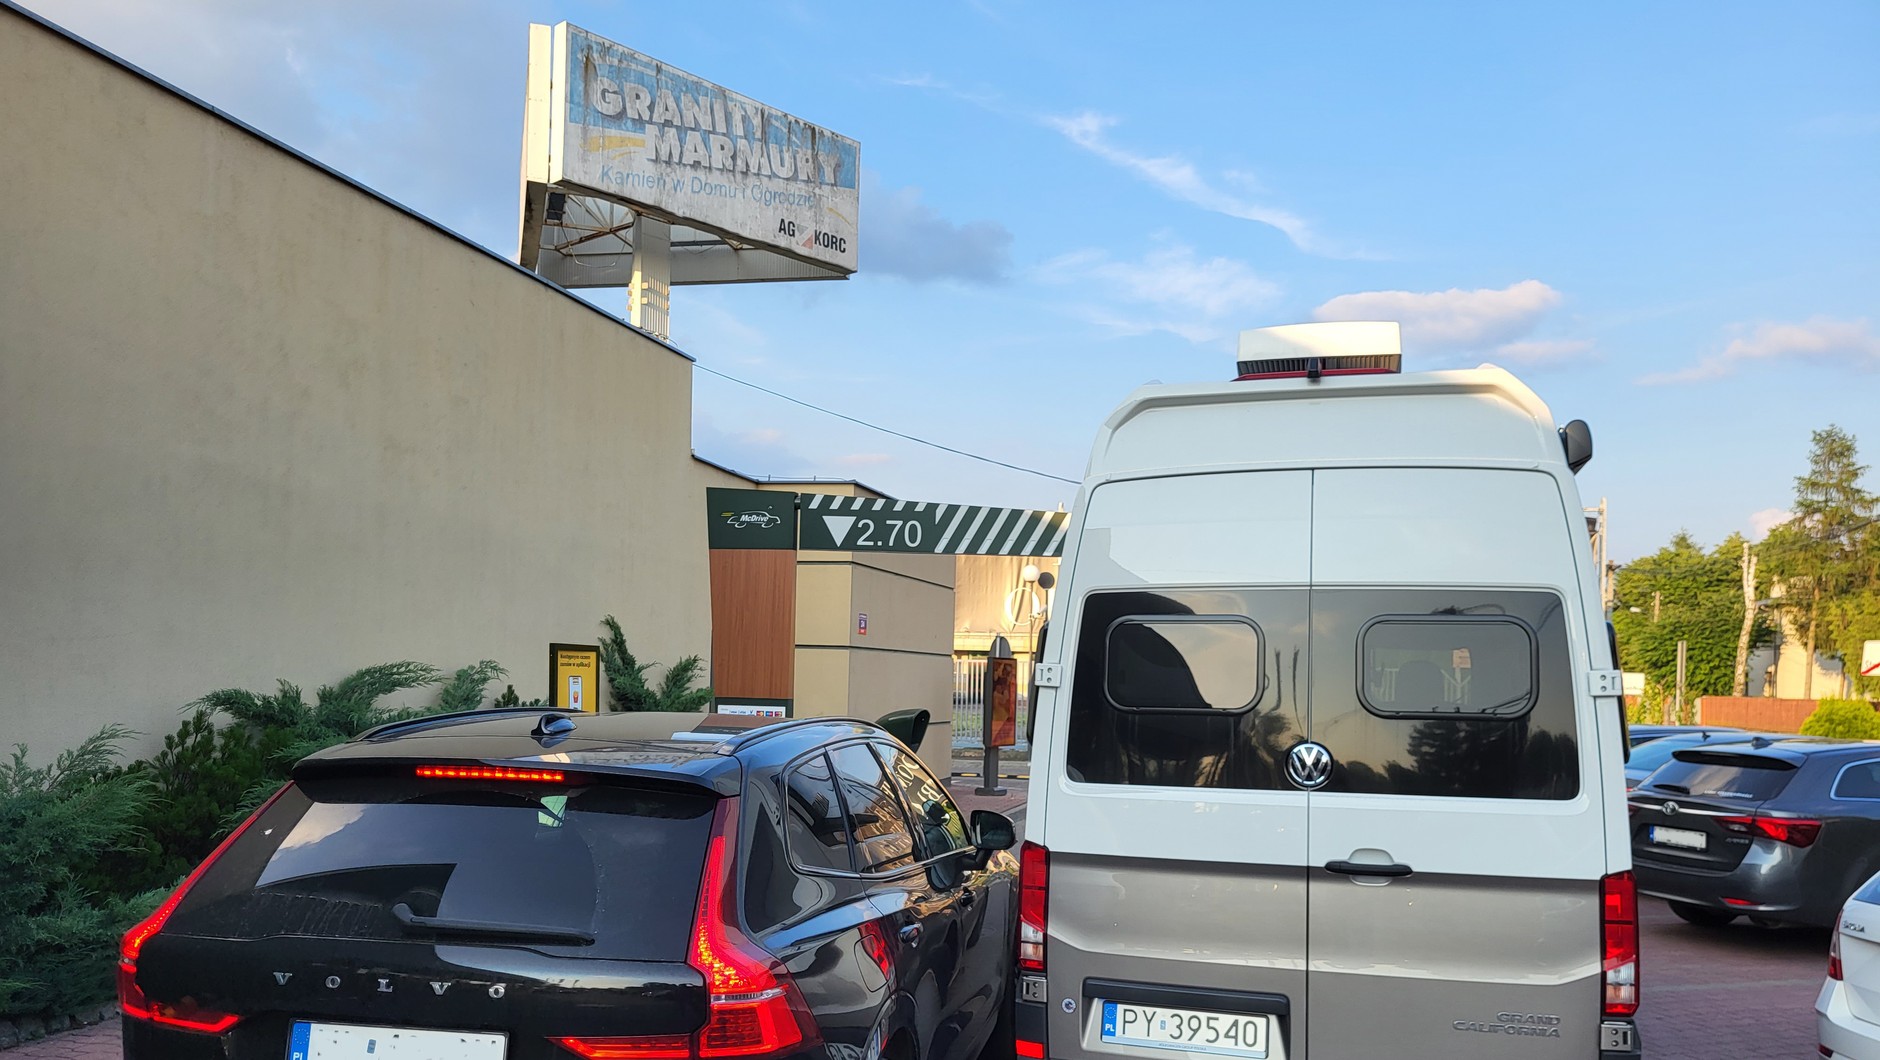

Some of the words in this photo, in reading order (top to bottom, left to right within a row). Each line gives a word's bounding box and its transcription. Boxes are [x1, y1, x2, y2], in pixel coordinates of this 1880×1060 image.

[593, 76, 765, 141] GRANITY
[648, 123, 842, 185] MARMURY
[672, 177, 685, 193] w
[691, 176, 736, 199] Domu
[778, 218, 796, 238] AG
[814, 229, 847, 253] KORC
[739, 514, 769, 522] McDrive
[856, 519, 923, 549] 2.70
[272, 971, 505, 999] VOLVO
[1104, 1023, 1115, 1032] PL
[1122, 1008, 1157, 1037] PY
[1169, 1013, 1258, 1048] 39540
[1452, 1020, 1560, 1038] CALIFORNIA
[1496, 1011, 1561, 1026] GRAND
